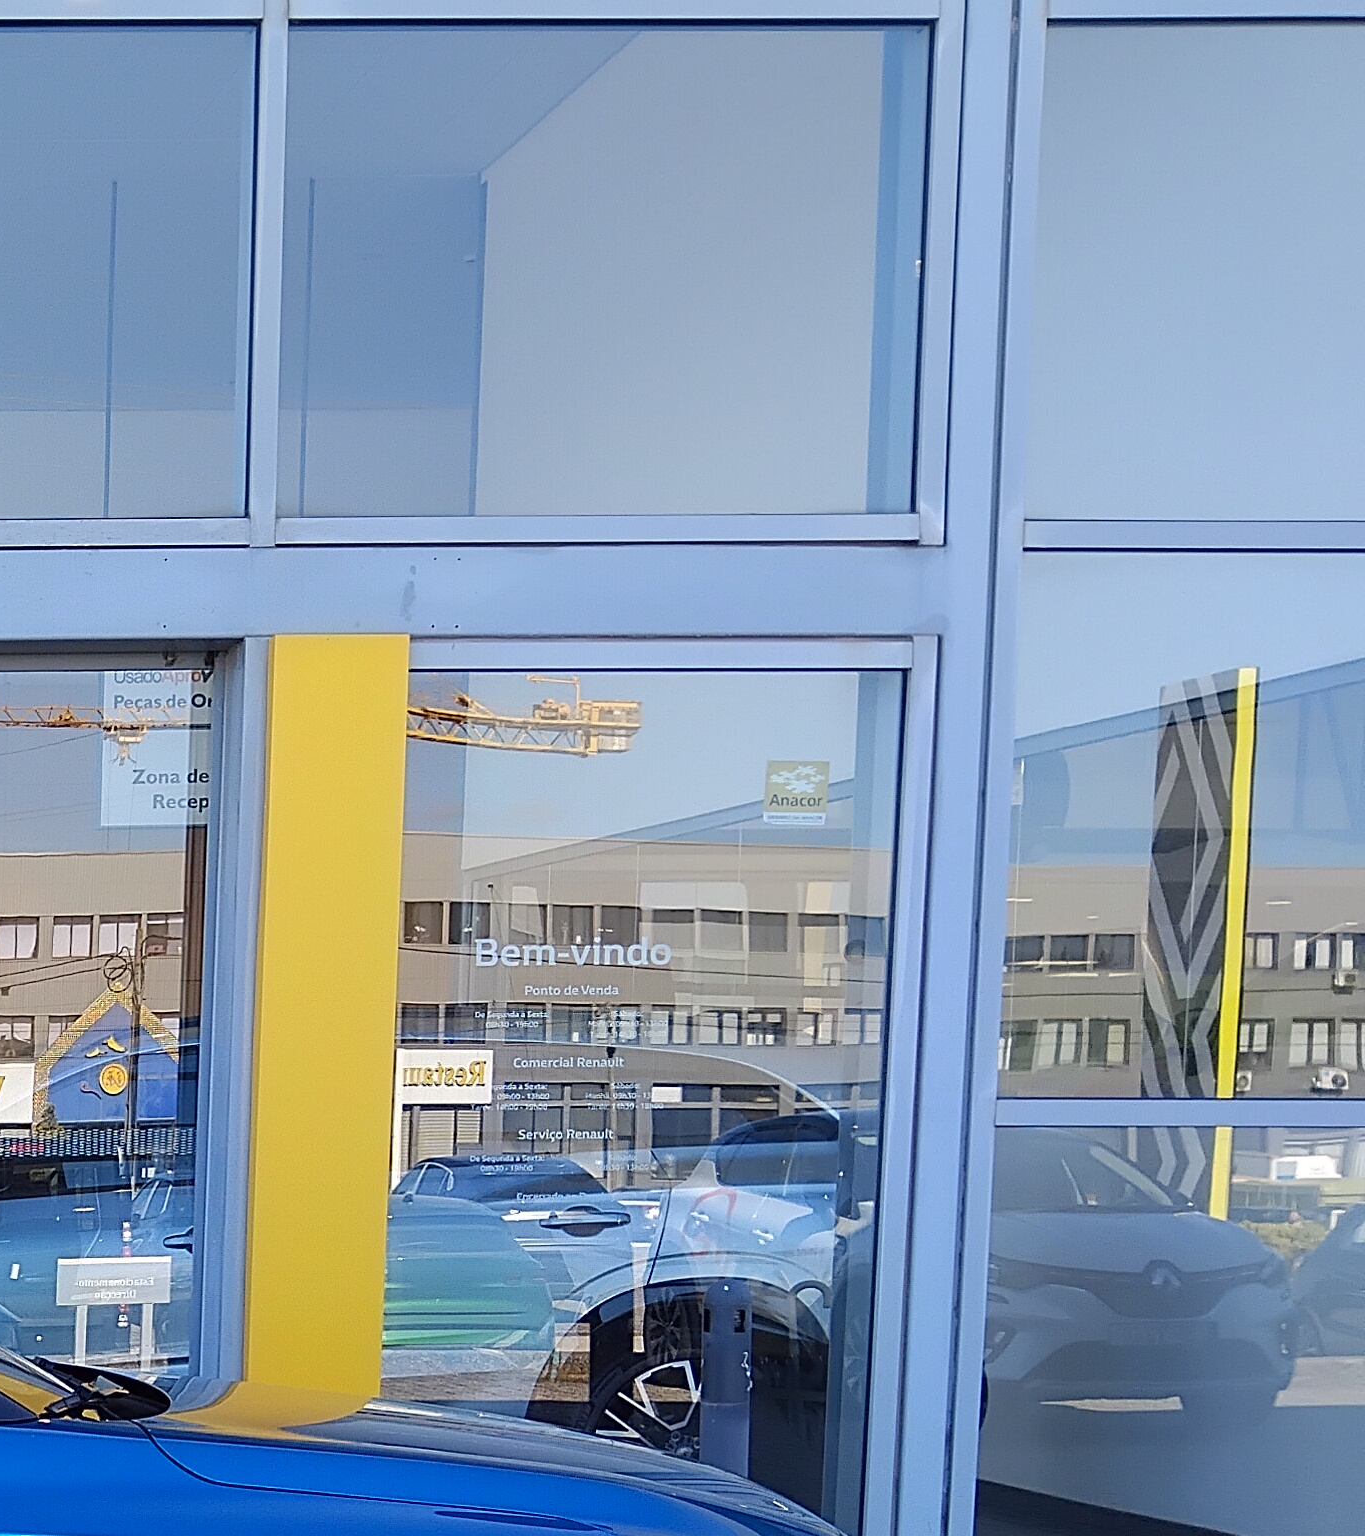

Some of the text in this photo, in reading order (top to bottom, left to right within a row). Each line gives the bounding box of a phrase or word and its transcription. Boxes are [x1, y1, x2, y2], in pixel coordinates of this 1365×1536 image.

[114, 671, 213, 685] UsadoAprov
[114, 695, 161, 711] Peças
[166, 694, 187, 708] de
[132, 768, 210, 784] Zona de
[152, 794, 209, 813] Recep
[769, 794, 823, 807] Anacor
[475, 936, 672, 967] Bem-vindo
[524, 984, 619, 996] Ponto de Venda
[513, 1056, 625, 1068] Comercial Renault
[517, 1128, 614, 1143] Serviço Renault
[481, 1154, 514, 1163] Segunda
